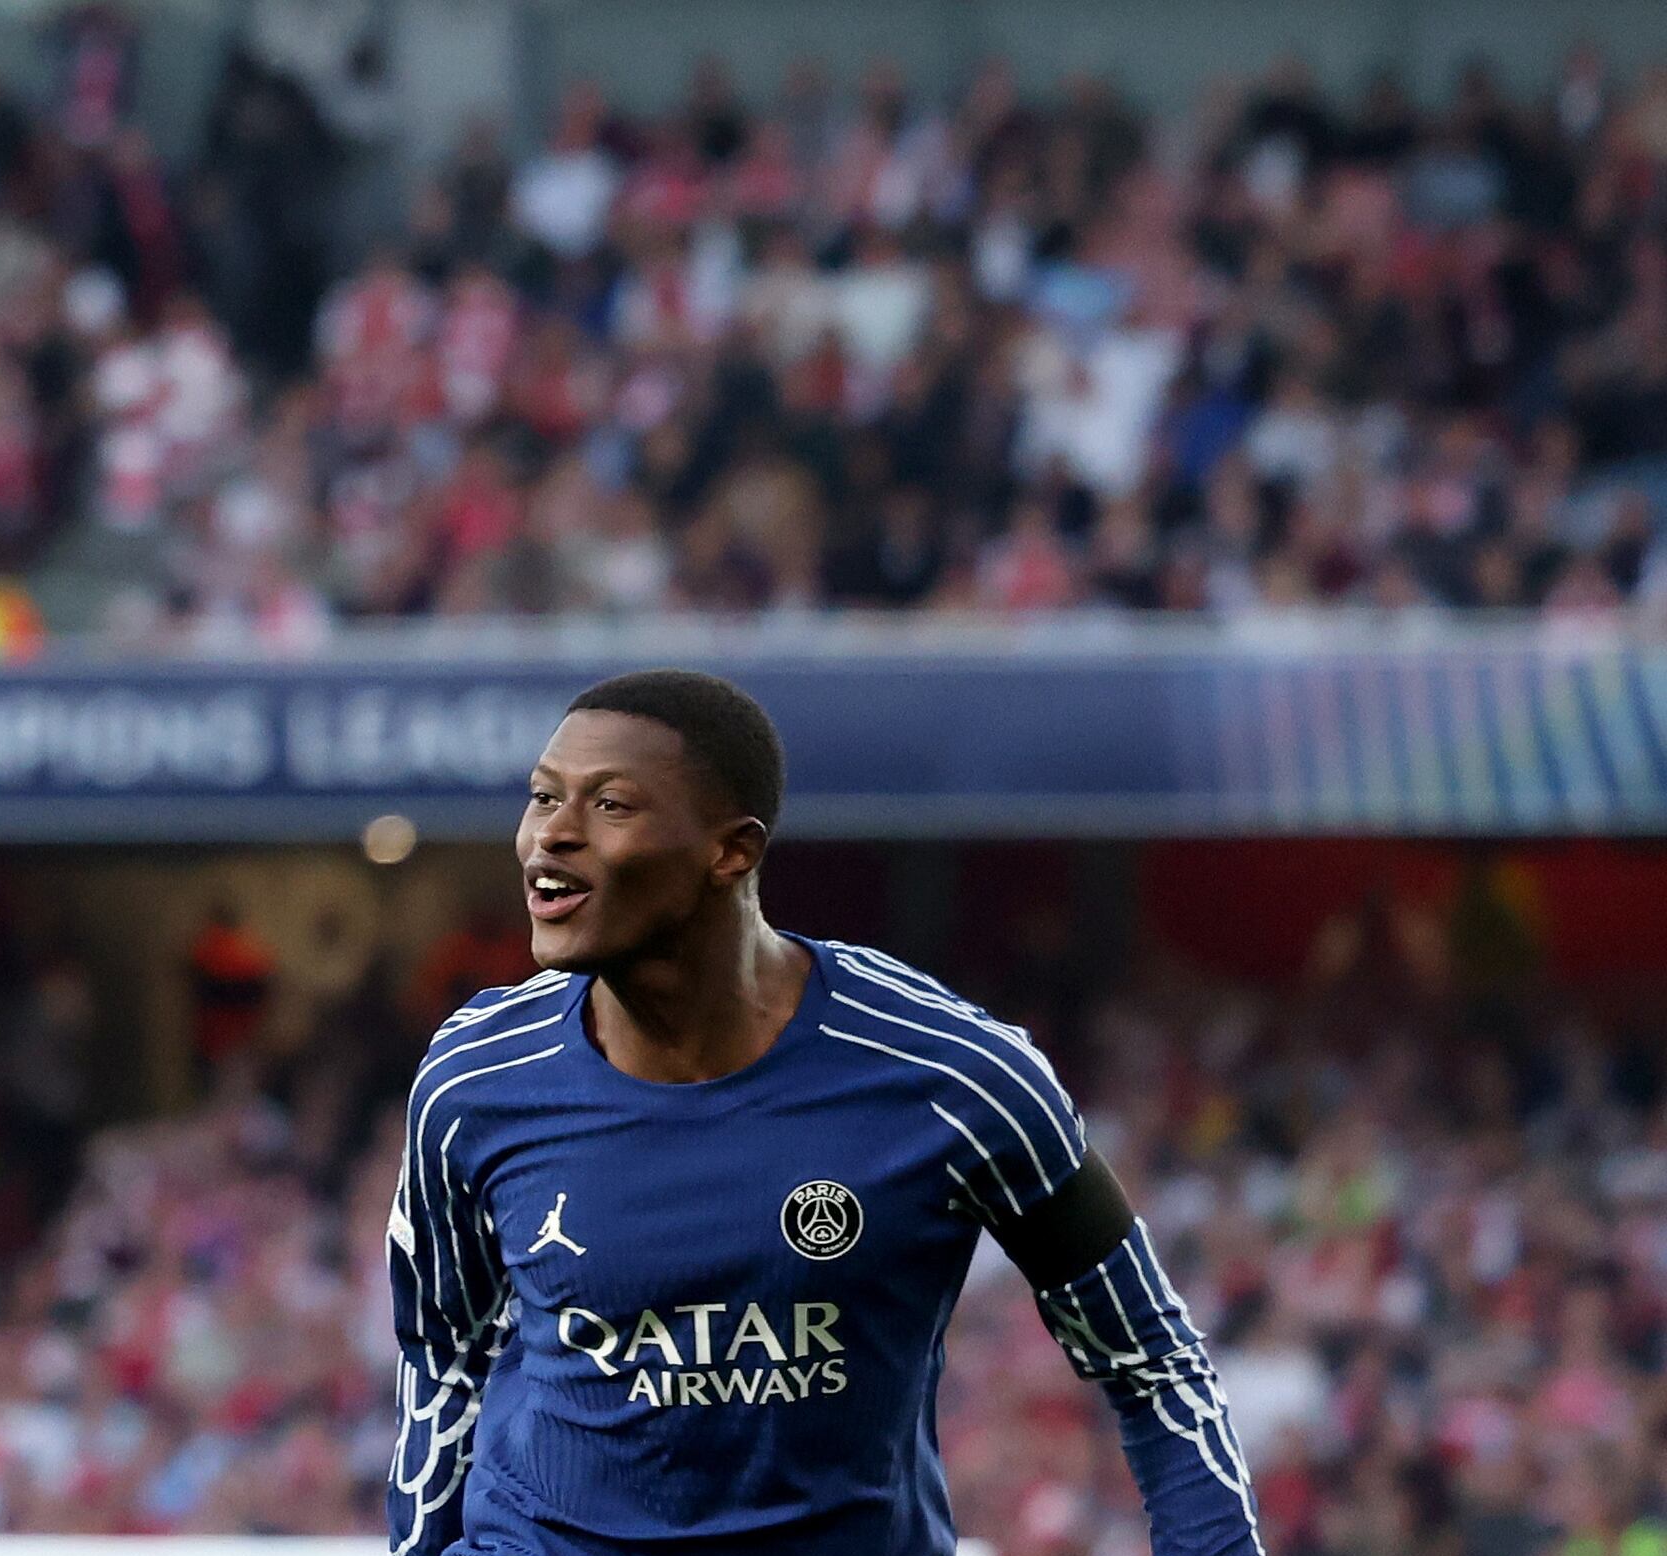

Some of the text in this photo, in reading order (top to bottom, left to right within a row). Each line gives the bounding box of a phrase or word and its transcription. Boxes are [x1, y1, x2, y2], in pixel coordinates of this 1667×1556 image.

[794, 1185, 848, 1205] PARIS
[558, 1302, 845, 1377] QATAR
[627, 1358, 848, 1408] AIRWAYS
